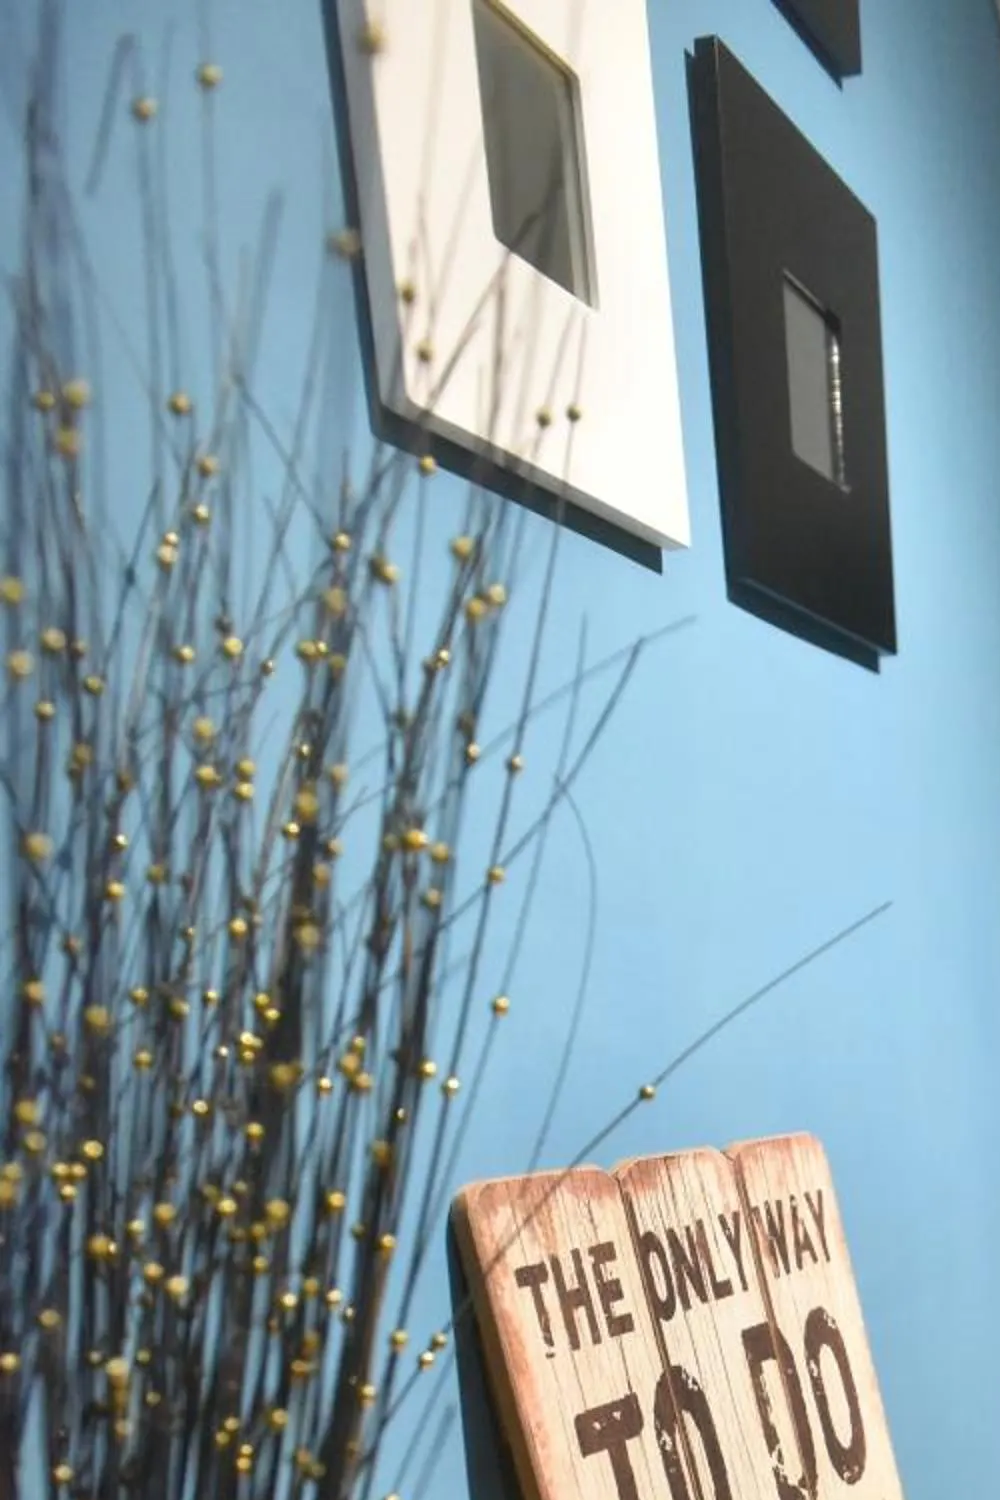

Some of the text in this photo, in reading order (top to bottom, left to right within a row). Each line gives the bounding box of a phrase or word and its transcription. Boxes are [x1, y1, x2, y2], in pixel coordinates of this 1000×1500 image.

[515, 1190, 834, 1357] THE ONLY WAY
